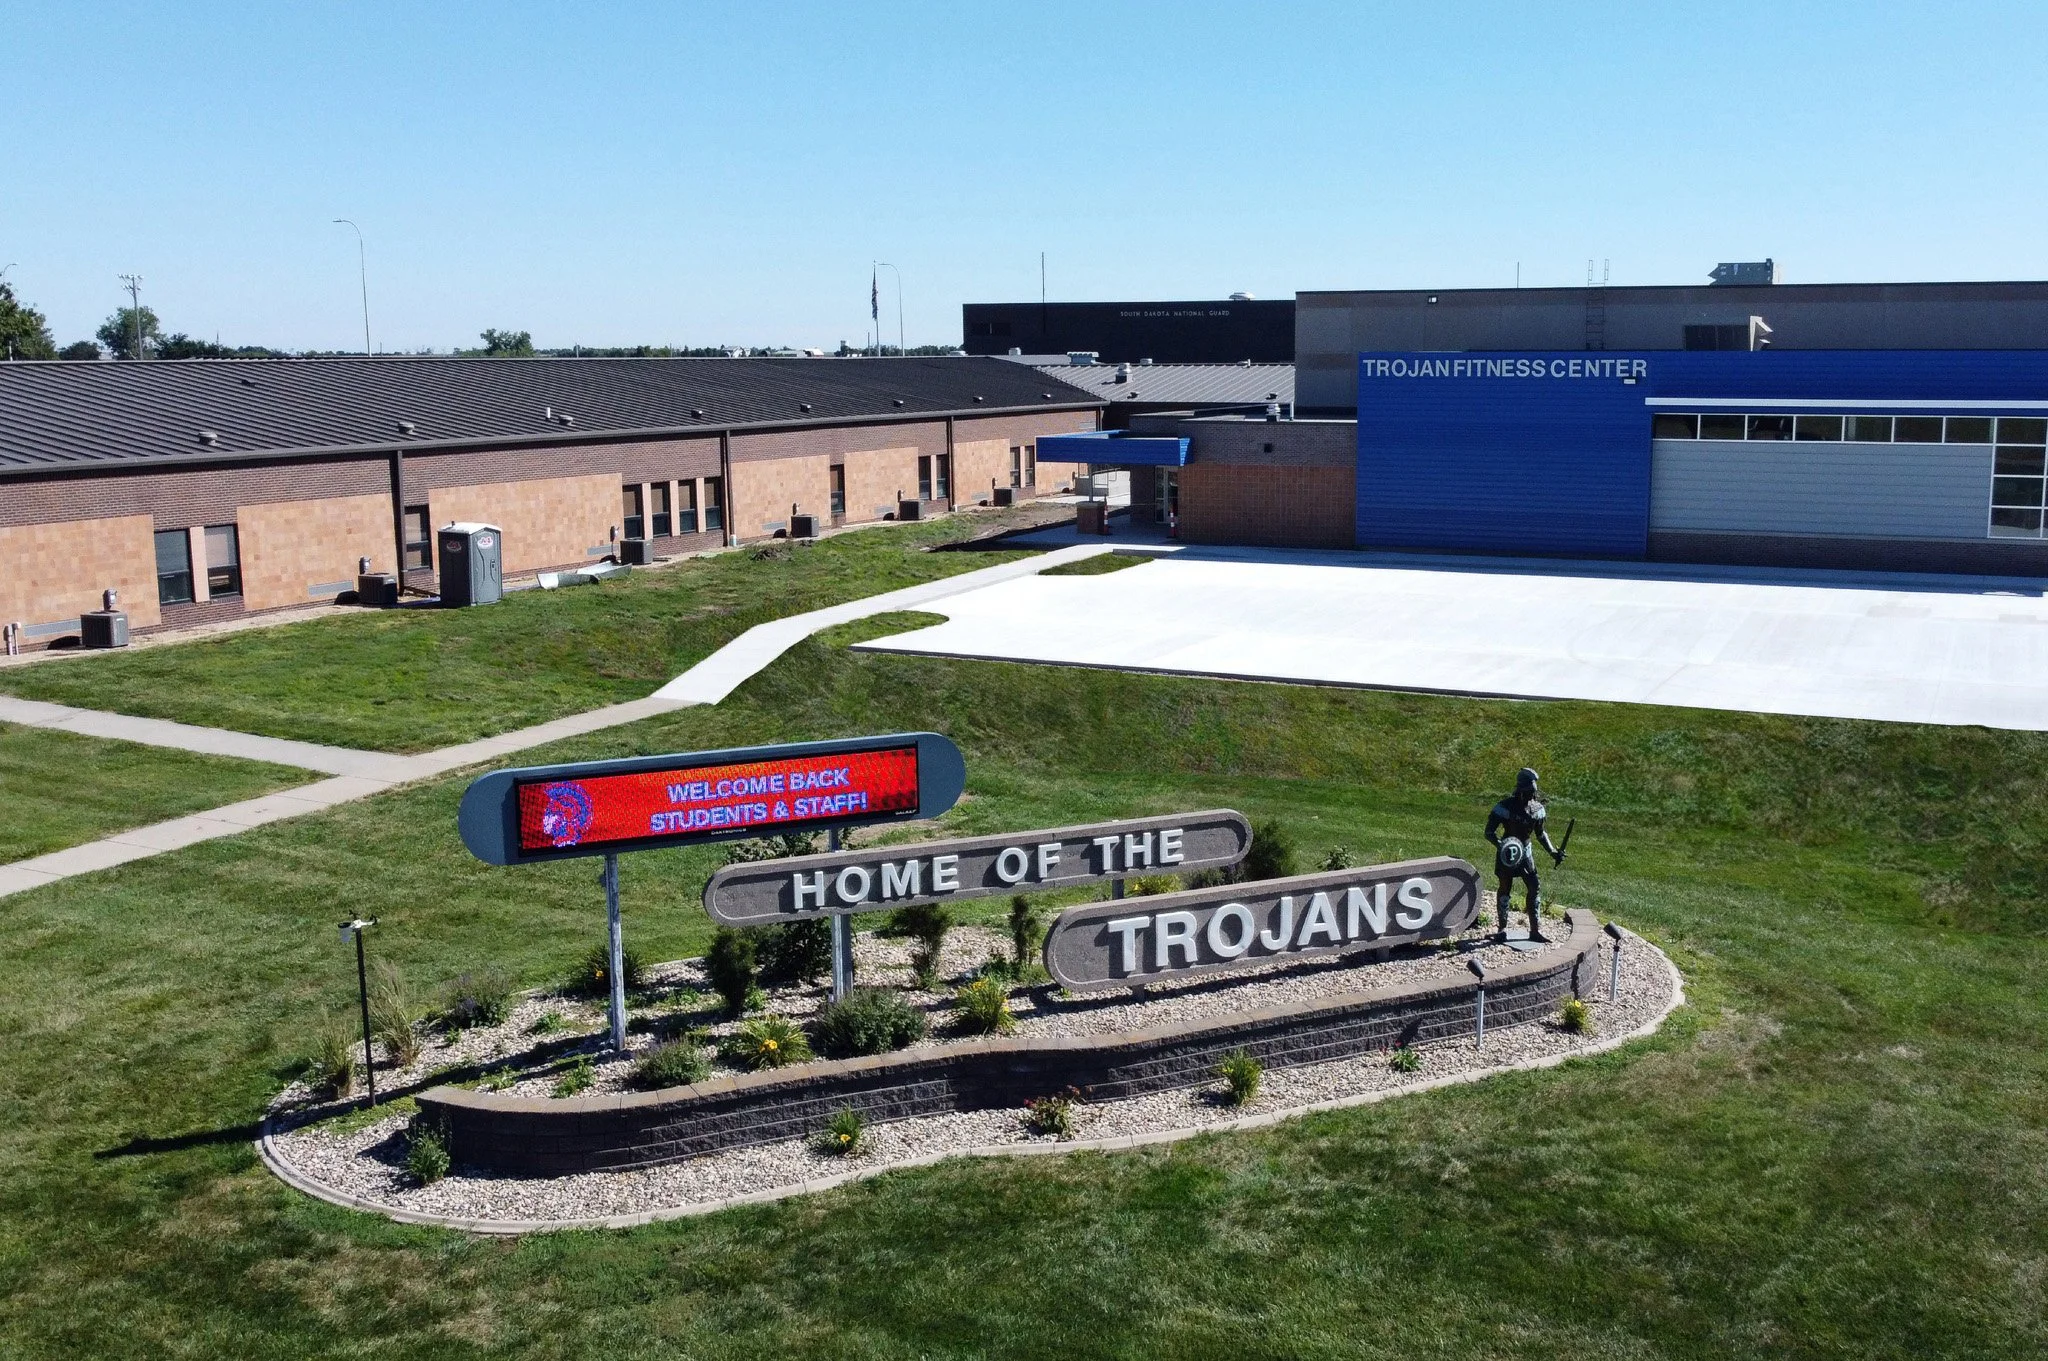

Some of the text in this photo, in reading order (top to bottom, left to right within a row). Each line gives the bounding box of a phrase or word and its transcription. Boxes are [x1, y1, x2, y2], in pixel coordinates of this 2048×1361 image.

[1362, 359, 1647, 377] TROJAN FITNESS CENTER
[667, 768, 850, 803] WELCOME BACK
[650, 791, 869, 832] STUDENTS & STAFF!
[793, 828, 1185, 909] HOME OF THE
[1508, 846, 1518, 861] P
[1107, 877, 1434, 972] TROJANS
